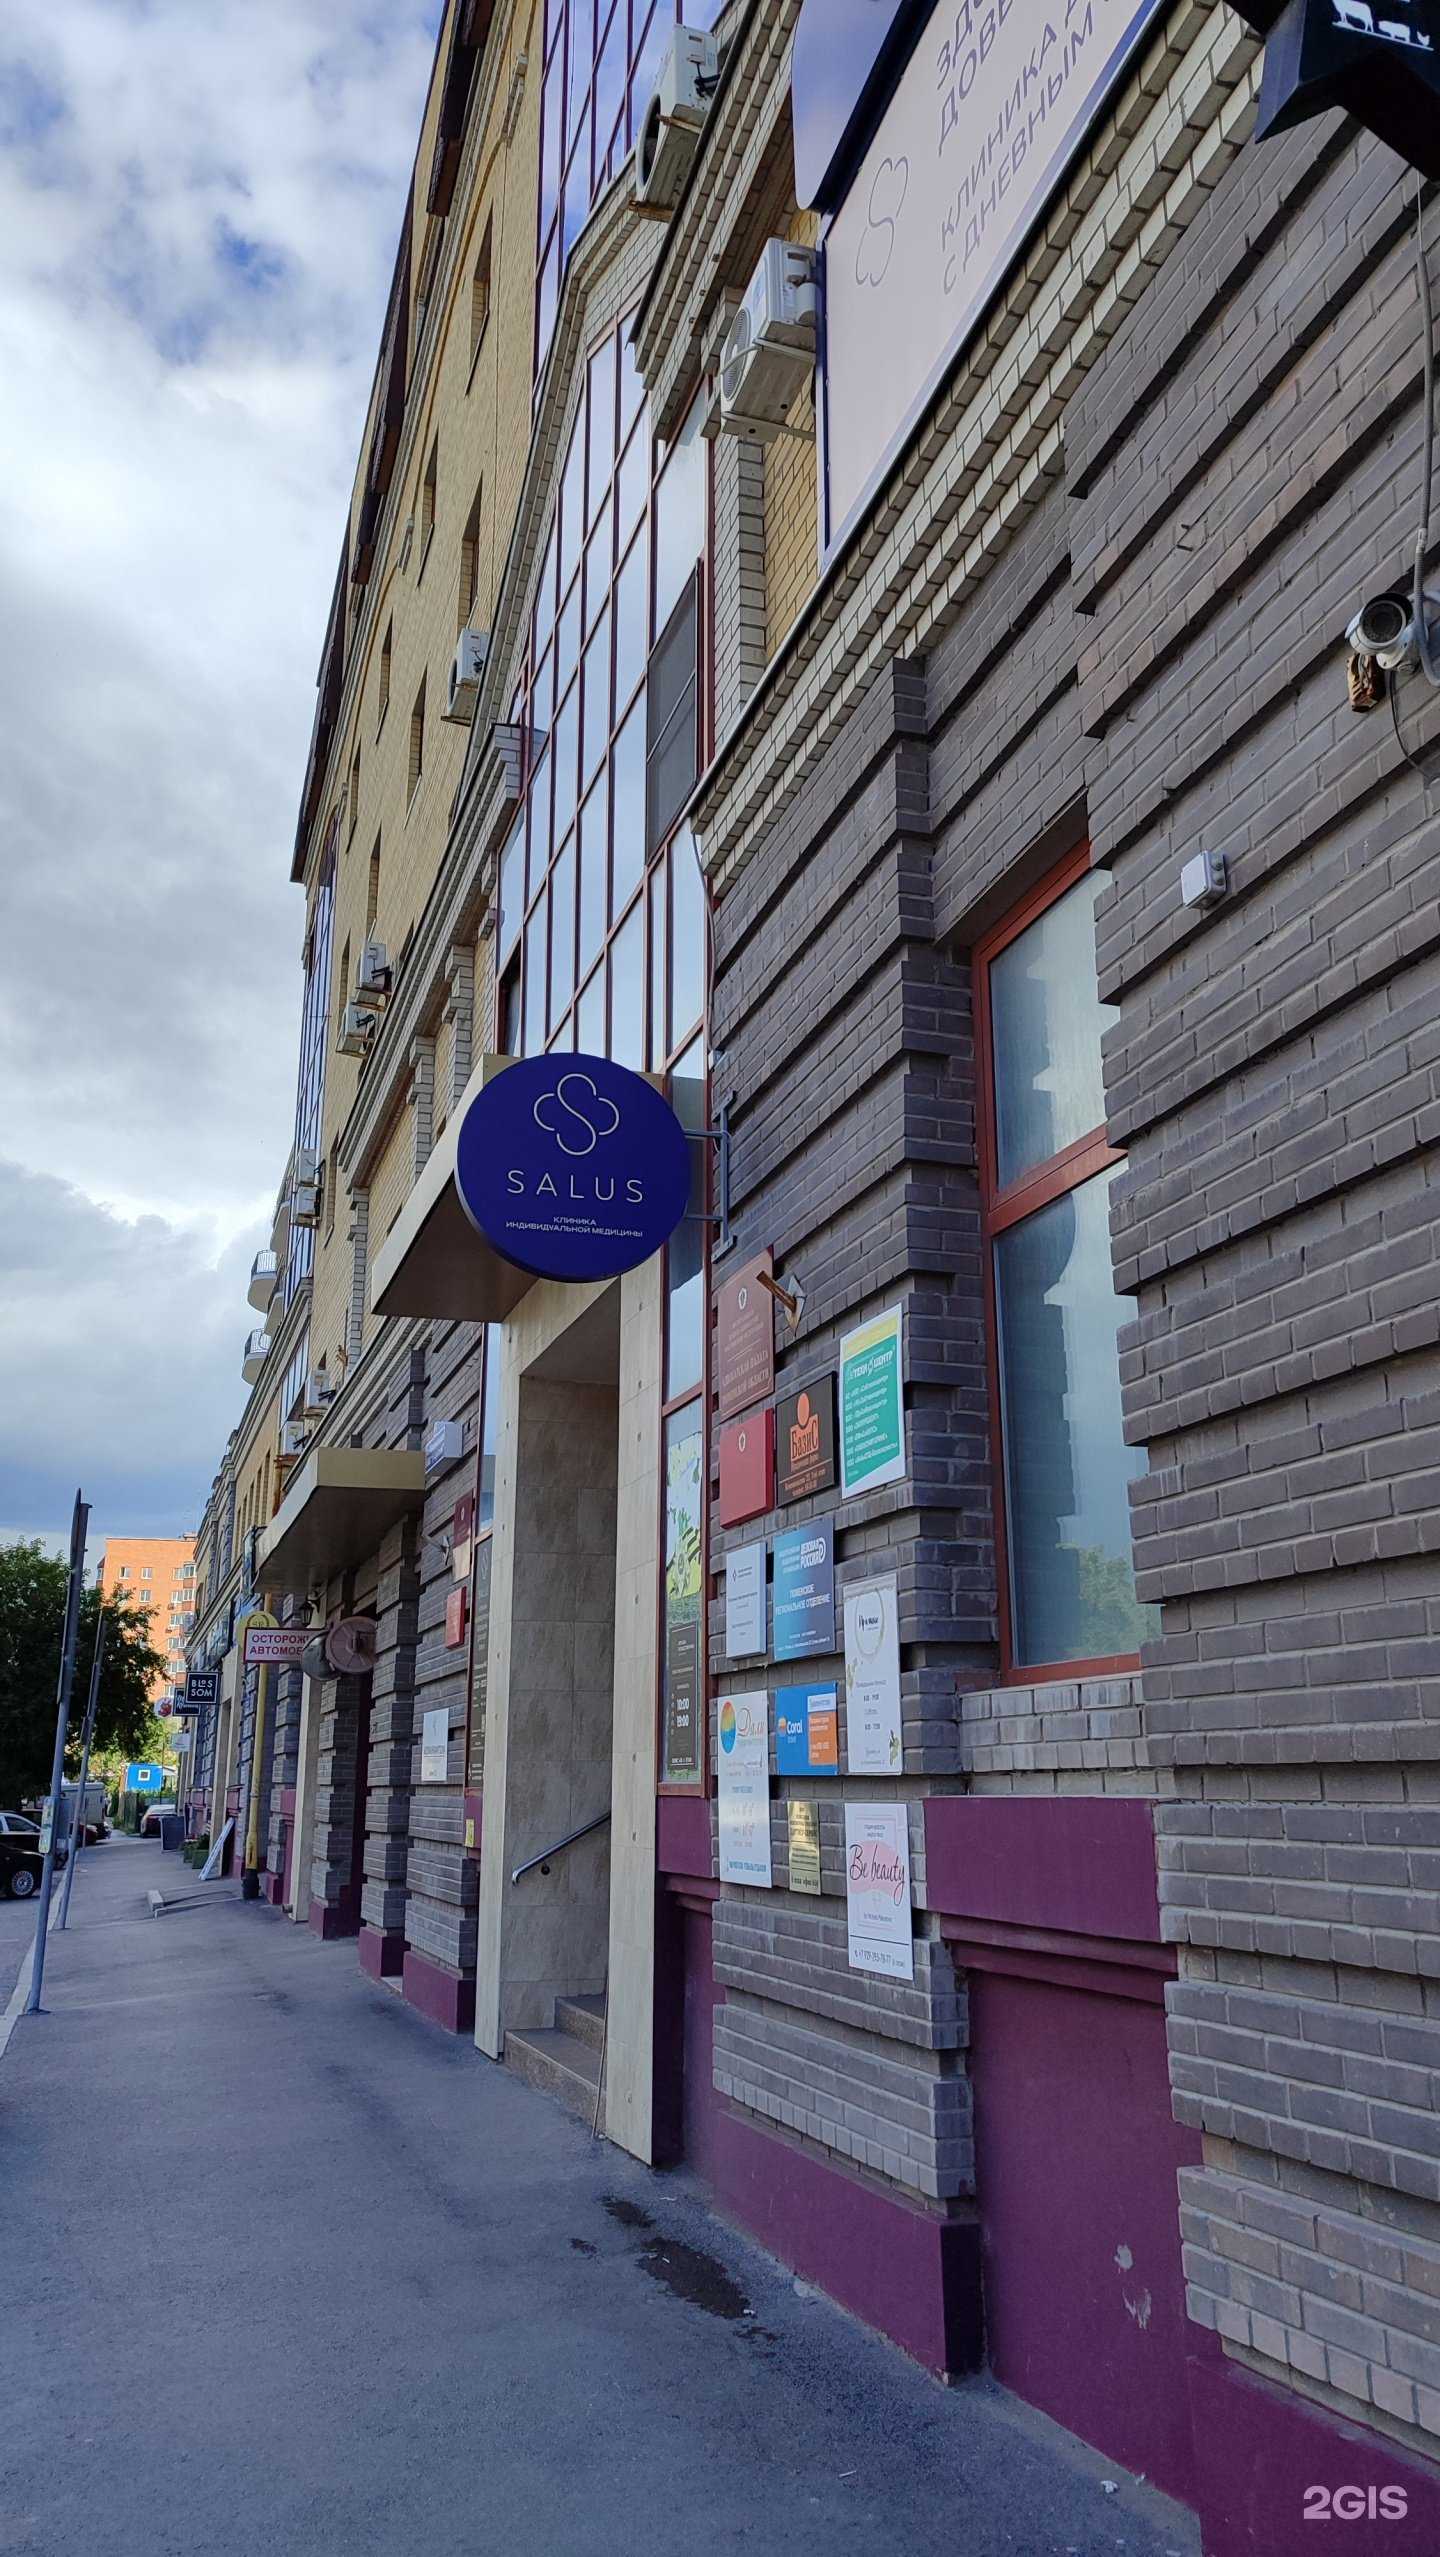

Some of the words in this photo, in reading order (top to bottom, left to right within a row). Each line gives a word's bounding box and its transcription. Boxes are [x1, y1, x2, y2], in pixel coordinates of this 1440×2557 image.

[936, 0, 983, 91] ЗД
[941, 22, 1057, 252] КЛИНИКА
[943, 254, 957, 295] С
[962, 1, 1093, 272] ДНЕВНЫМ
[506, 1169, 643, 1203] SALUS
[505, 1221, 591, 1234] ИНДИВИДУАЛЬНОЙ
[592, 1227, 643, 1237] МЕДИЦИНЫ
[553, 1216, 597, 1226] КЛИНИКА
[252, 1634, 309, 1644] ОСТОРОЖ
[191, 1688, 213, 1697] SOM
[787, 1719, 803, 1735] Coral
[849, 1844, 868, 1881] Be
[871, 1843, 905, 1907] beauty
